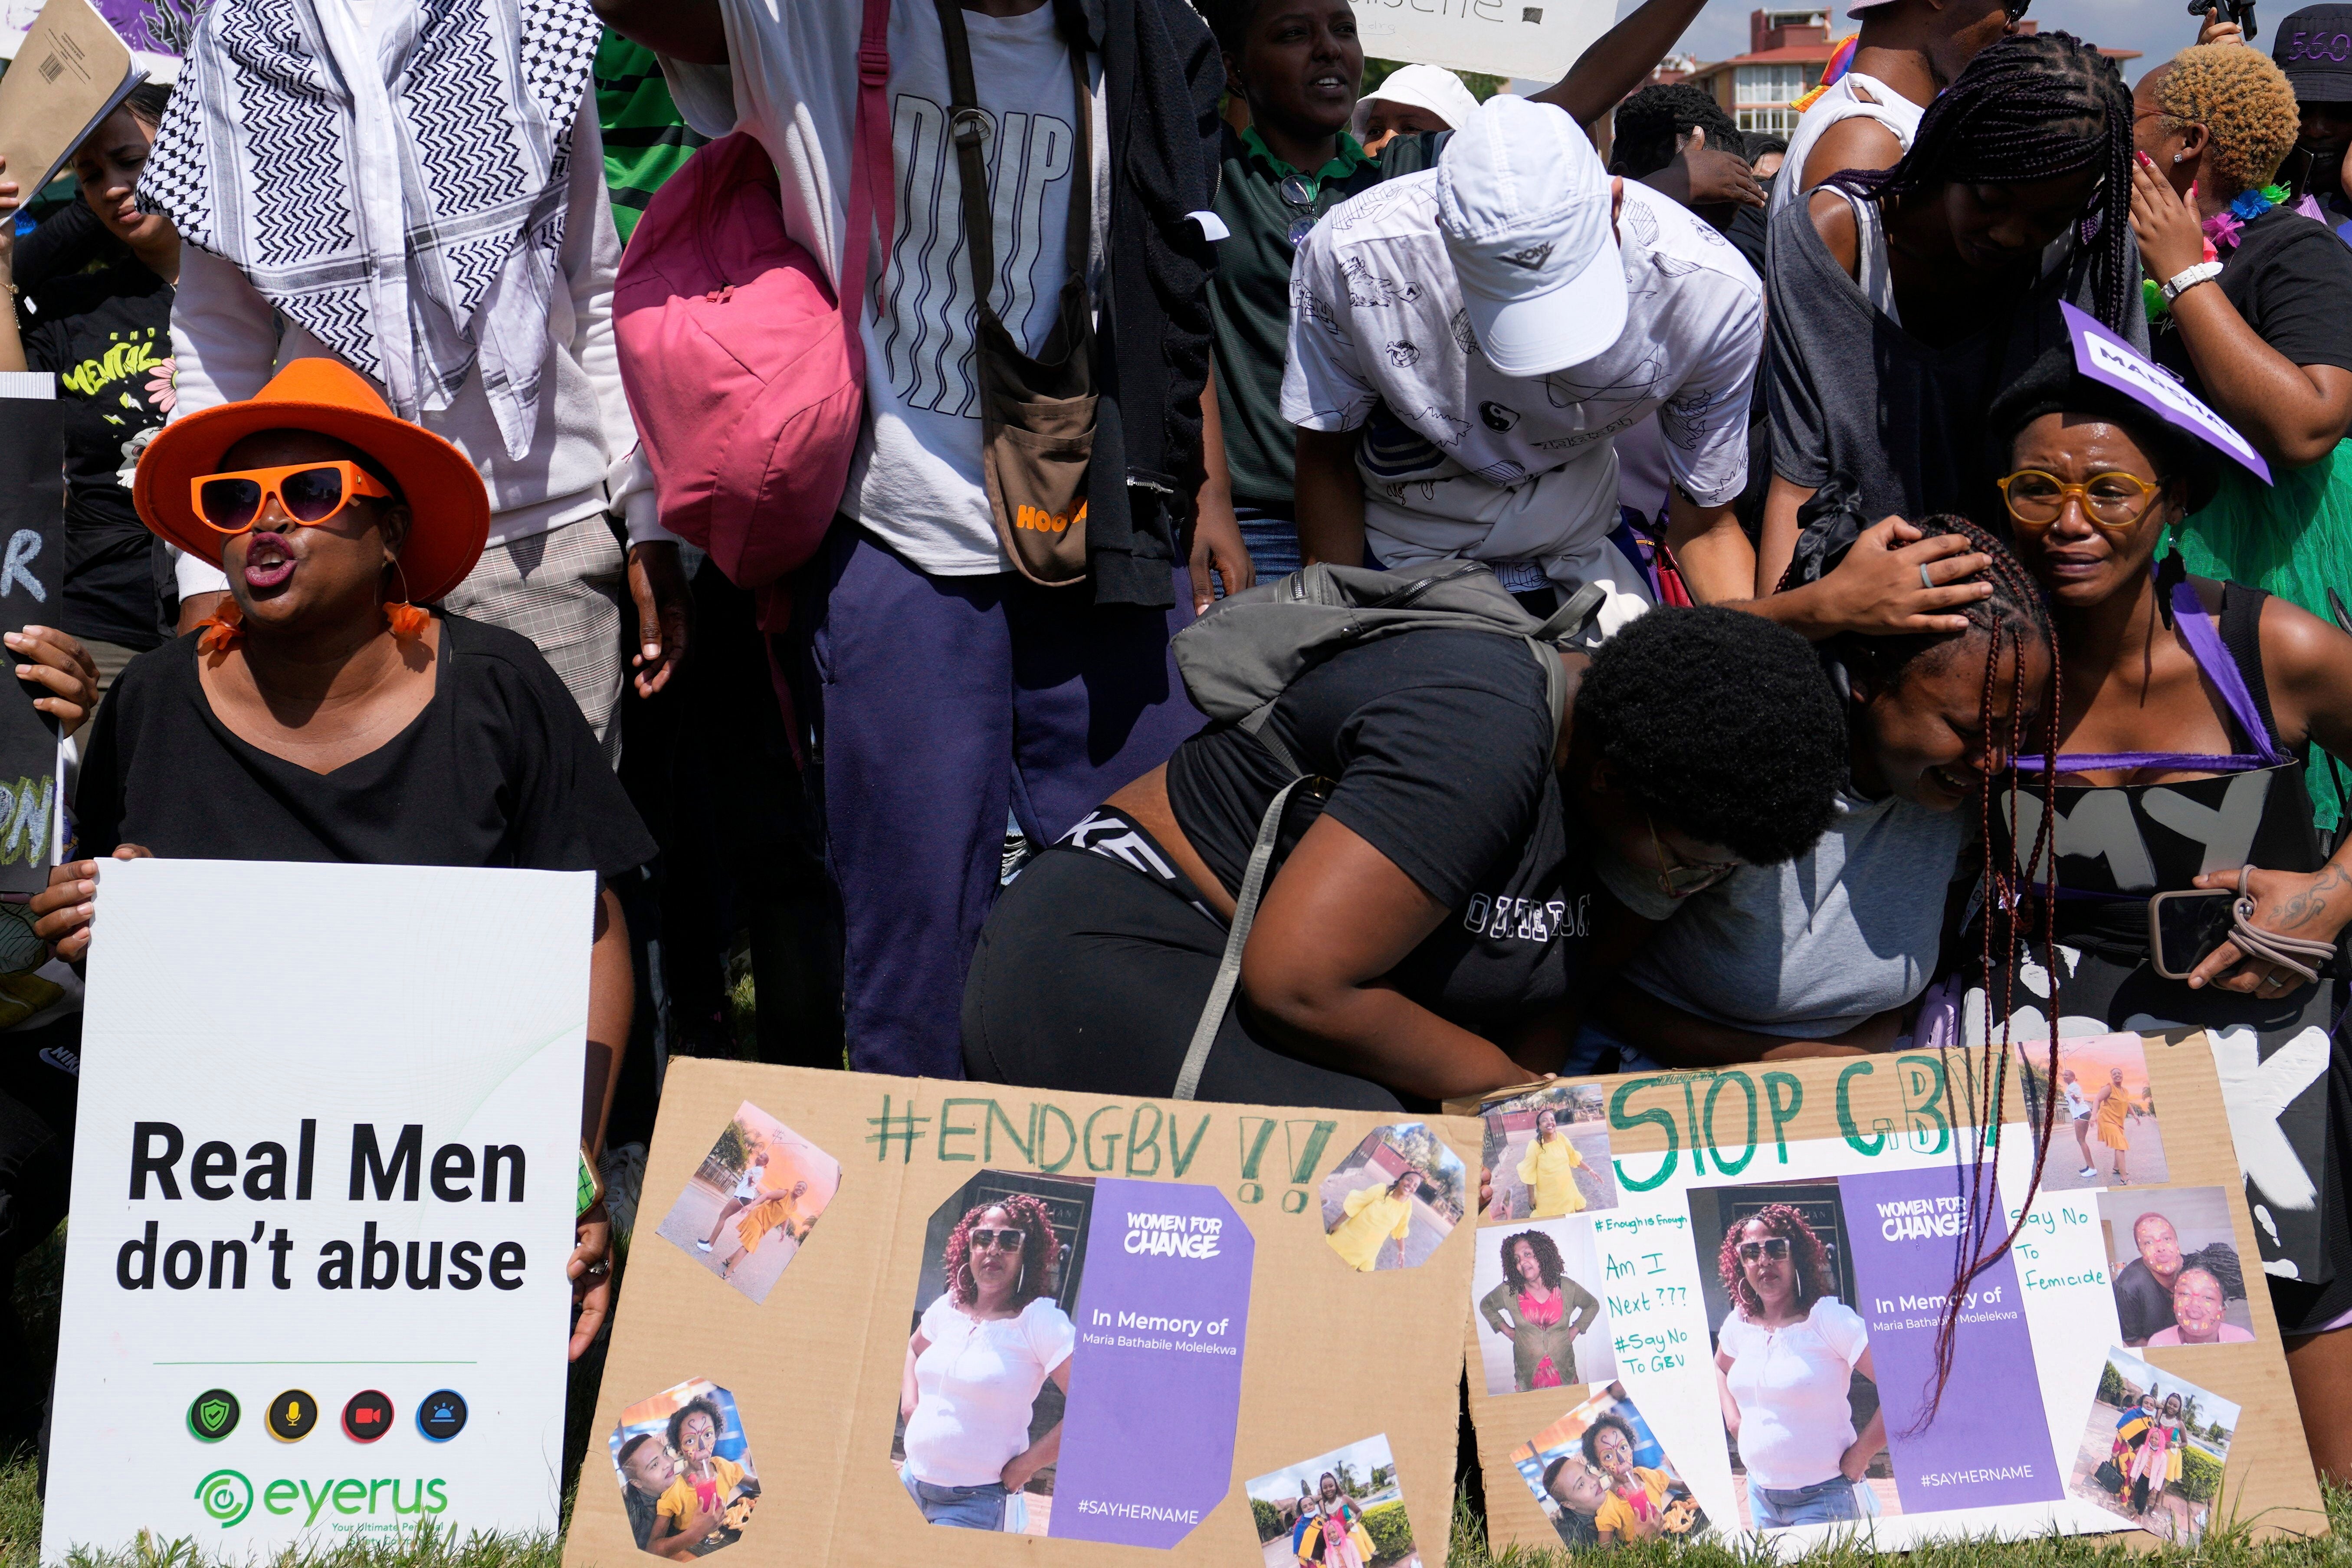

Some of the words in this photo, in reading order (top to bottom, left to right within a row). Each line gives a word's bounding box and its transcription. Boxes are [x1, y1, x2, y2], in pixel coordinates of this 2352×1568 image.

[2288, 32, 2351, 62] 560
[1515, 240, 1550, 260] PONY
[62, 341, 162, 396] MENTAL
[2100, 346, 2241, 442] MARSHAL
[2001, 771, 2273, 892] MY
[1608, 1070, 1804, 1192] STOP
[1836, 1052, 2010, 1156] GBV
[129, 1119, 316, 1201] Real
[348, 1123, 526, 1203] Men
[1876, 1199, 1934, 1218] WOMEN
[1935, 1196, 1967, 1212] FOR
[2011, 1208, 2056, 1235] Say
[2063, 1207, 2089, 1225] No
[1127, 1212, 1186, 1233] WOMEN
[1190, 1216, 1223, 1234] FOR
[1882, 1212, 1973, 1242] CHANGE
[317, 1221, 526, 1291] abuse
[1124, 1230, 1221, 1260] CHANGE
[2015, 1244, 2039, 1260] To
[1606, 1253, 1636, 1281] Am
[1641, 1253, 1666, 1275] I
[2025, 1269, 2106, 1291] Femicide
[1607, 1291, 1650, 1319] Next
[1875, 1298, 1895, 1314] In
[1899, 1292, 1978, 1312] Memory
[1983, 1286, 2002, 1304] of
[1092, 1309, 1111, 1326] In
[1117, 1311, 1203, 1338] Memory
[1207, 1318, 1229, 1336] of
[1873, 1320, 1903, 1332] Maria
[1959, 1310, 2018, 1324] Molelekwa
[1083, 1332, 1115, 1345] Maria
[1117, 1335, 1172, 1350] Bathabile
[1175, 1341, 1237, 1355] Molelekwa
[1622, 1358, 1645, 1375] To
[1651, 1354, 1685, 1372] GBV
[1920, 1464, 2034, 1487] #SAYHERNAME
[263, 1478, 448, 1528] eyerus
[1077, 1499, 1199, 1525] #SAYHERNAME
[332, 1523, 354, 1532] Your
